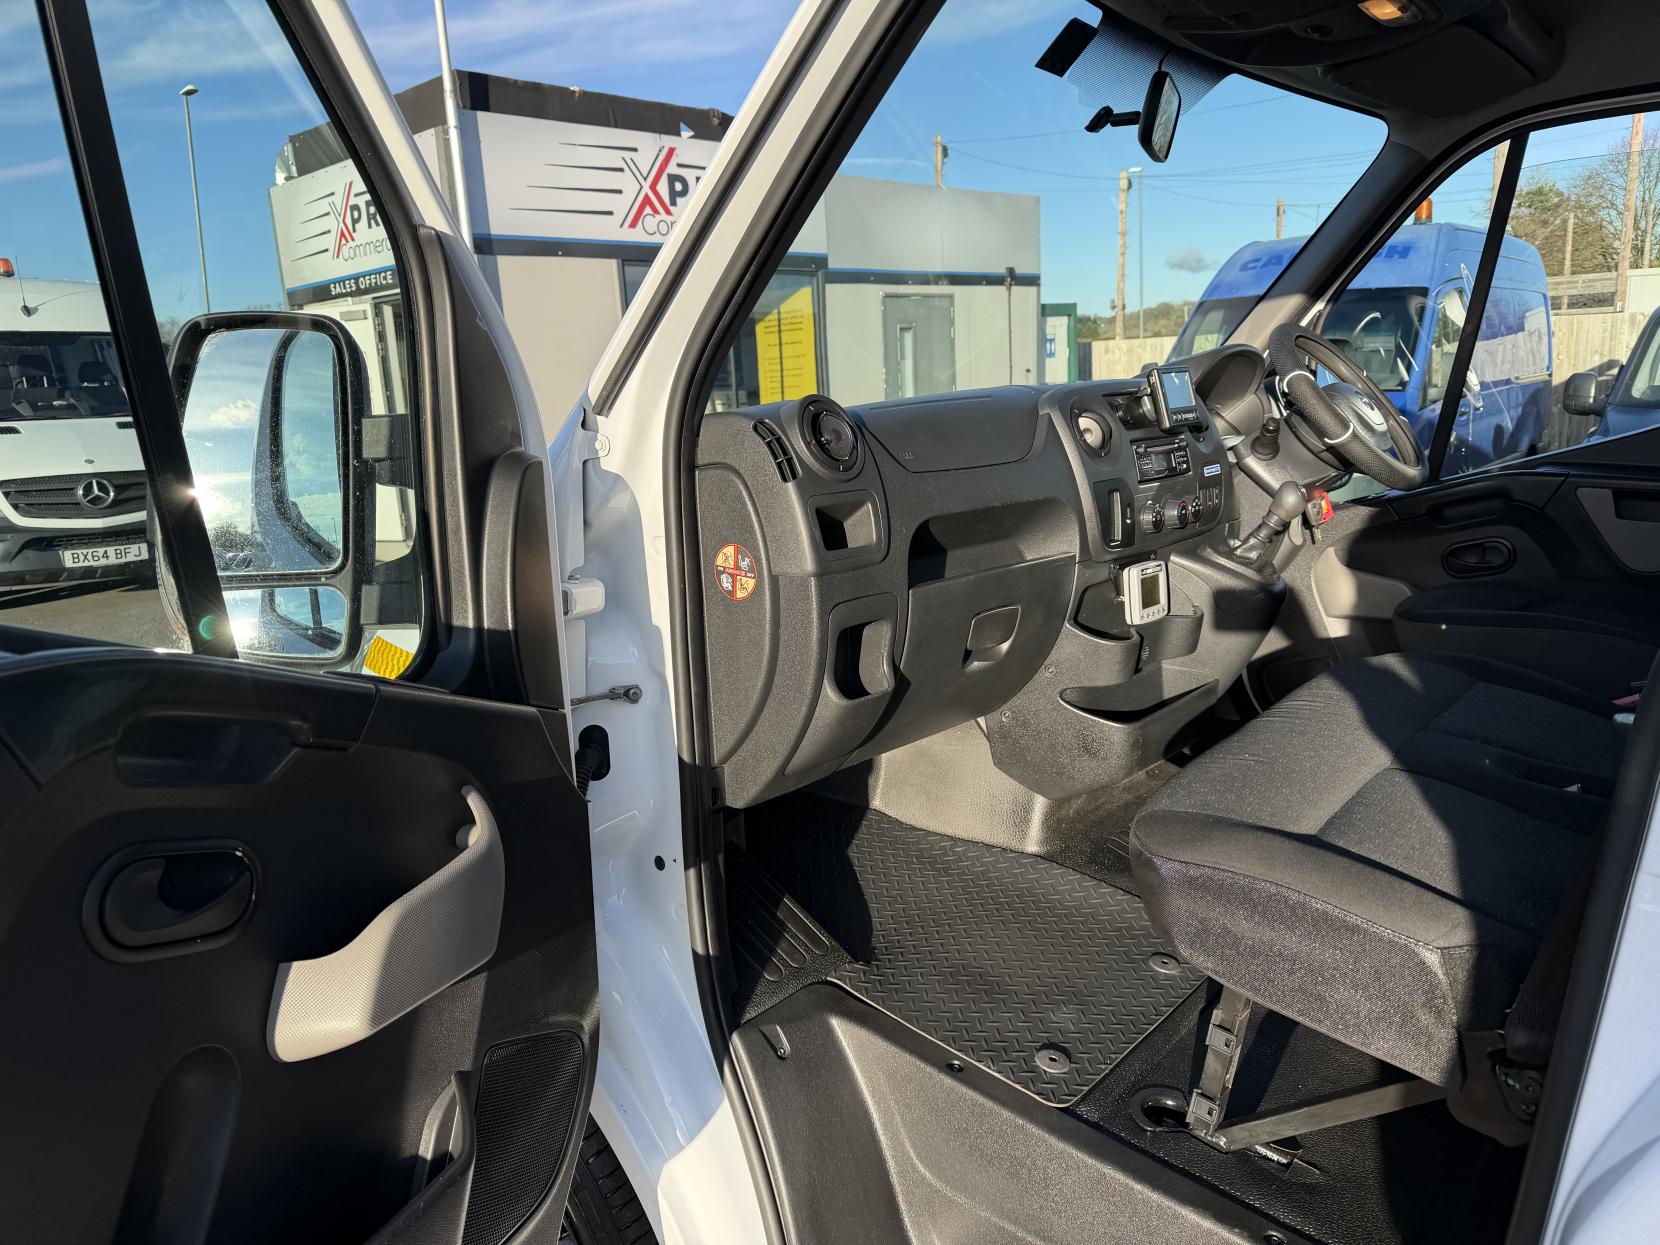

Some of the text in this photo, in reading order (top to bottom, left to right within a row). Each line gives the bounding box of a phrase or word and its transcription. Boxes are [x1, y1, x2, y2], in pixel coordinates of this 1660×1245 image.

[619, 145, 702, 229] XP
[328, 180, 381, 260] XPR
[341, 237, 392, 261] Commerc
[330, 271, 393, 295] SALES OFFICE
[71, 546, 142, 564] BX64 BFJ
